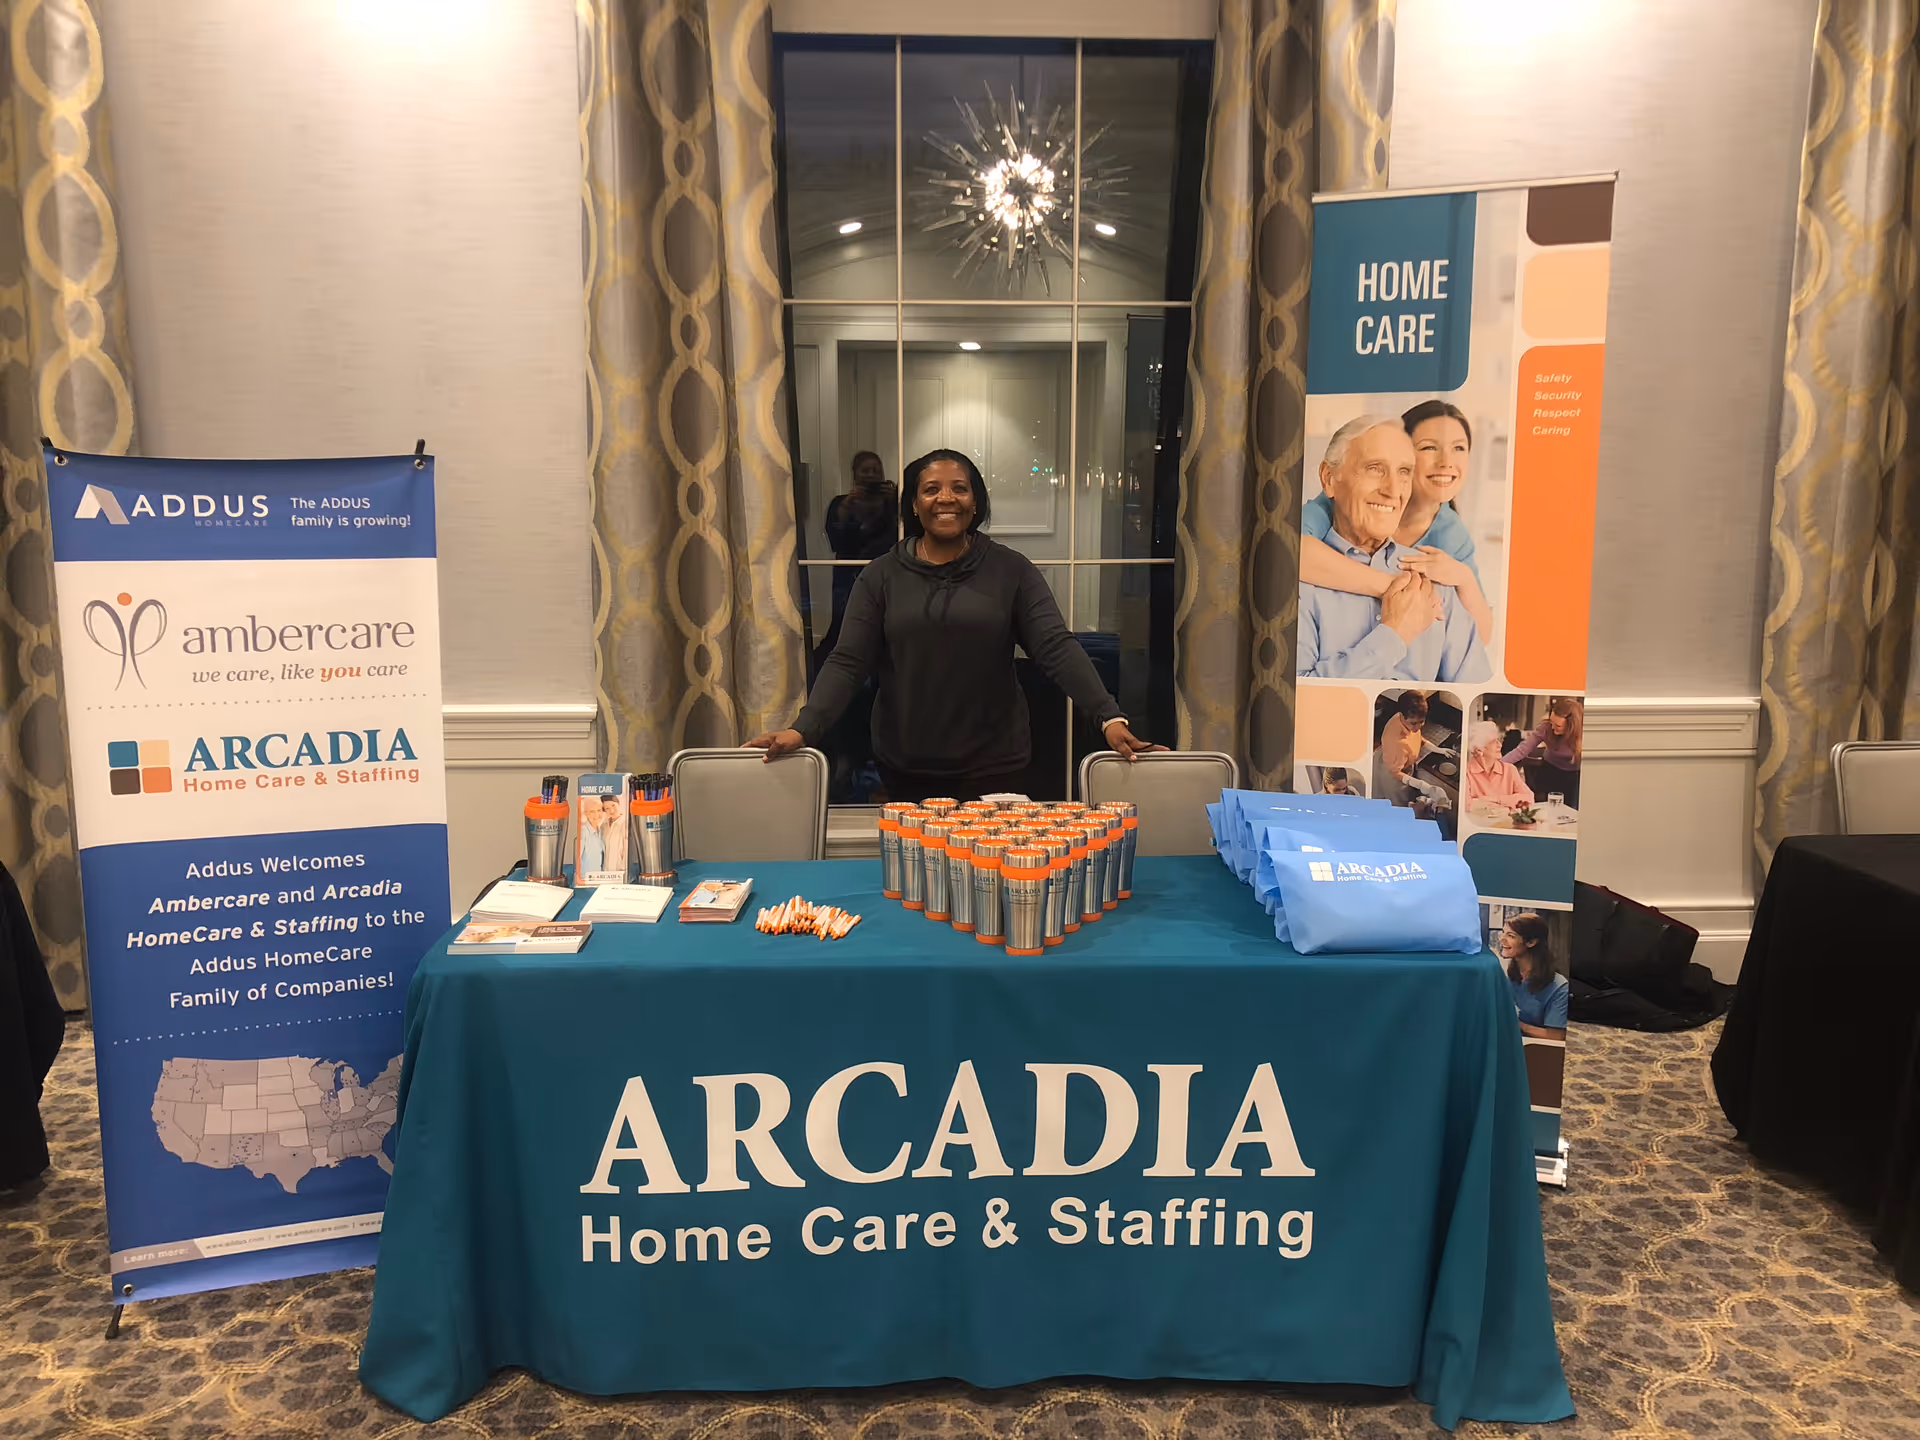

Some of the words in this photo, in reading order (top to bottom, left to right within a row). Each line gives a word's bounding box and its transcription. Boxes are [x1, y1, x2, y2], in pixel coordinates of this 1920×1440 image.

[1357, 259, 1449, 302] HOME
[1355, 313, 1436, 355] CARE
[1535, 373, 1572, 385] Safety
[1533, 390, 1582, 402] Security
[1532, 407, 1581, 418] Respect
[1531, 425, 1571, 437] Caring
[131, 494, 269, 518] ADDUS
[290, 497, 317, 509] The
[320, 497, 371, 509] ADDUS
[291, 514, 333, 529] family
[337, 515, 350, 527] is
[354, 514, 411, 529] growing!
[182, 615, 415, 655] ambercare
[192, 670, 222, 683] we
[226, 667, 276, 685] care,
[281, 664, 315, 681] like
[319, 664, 362, 683] you
[367, 663, 408, 677] care
[184, 727, 418, 773] ARCADIA
[183, 776, 247, 793] Home
[255, 772, 306, 789] Care
[314, 771, 329, 786] &
[336, 767, 421, 785] Staffing
[599, 785, 614, 793] CARE
[185, 856, 253, 880] Addus
[260, 851, 366, 874] Welcomes
[1336, 862, 1424, 878] ARCADIA
[148, 889, 270, 915] Ambercare
[277, 885, 315, 904] and
[322, 879, 403, 901] Arcadia
[126, 923, 243, 949] HomeCare
[249, 921, 266, 938] &
[273, 913, 359, 937] Staffing
[364, 911, 386, 929] to
[392, 908, 425, 926] the
[190, 953, 258, 976] Addus
[264, 944, 373, 968] HomeCare
[169, 984, 240, 1009] Family
[247, 983, 268, 1000] of
[274, 972, 394, 999] Companies!
[580, 1060, 1316, 1195] ARCADIA
[580, 1214, 772, 1263] Home
[801, 1206, 957, 1256] Care
[981, 1198, 1020, 1249] &
[1047, 1196, 1316, 1259] Staffing
[123, 1251, 156, 1264] Learn
